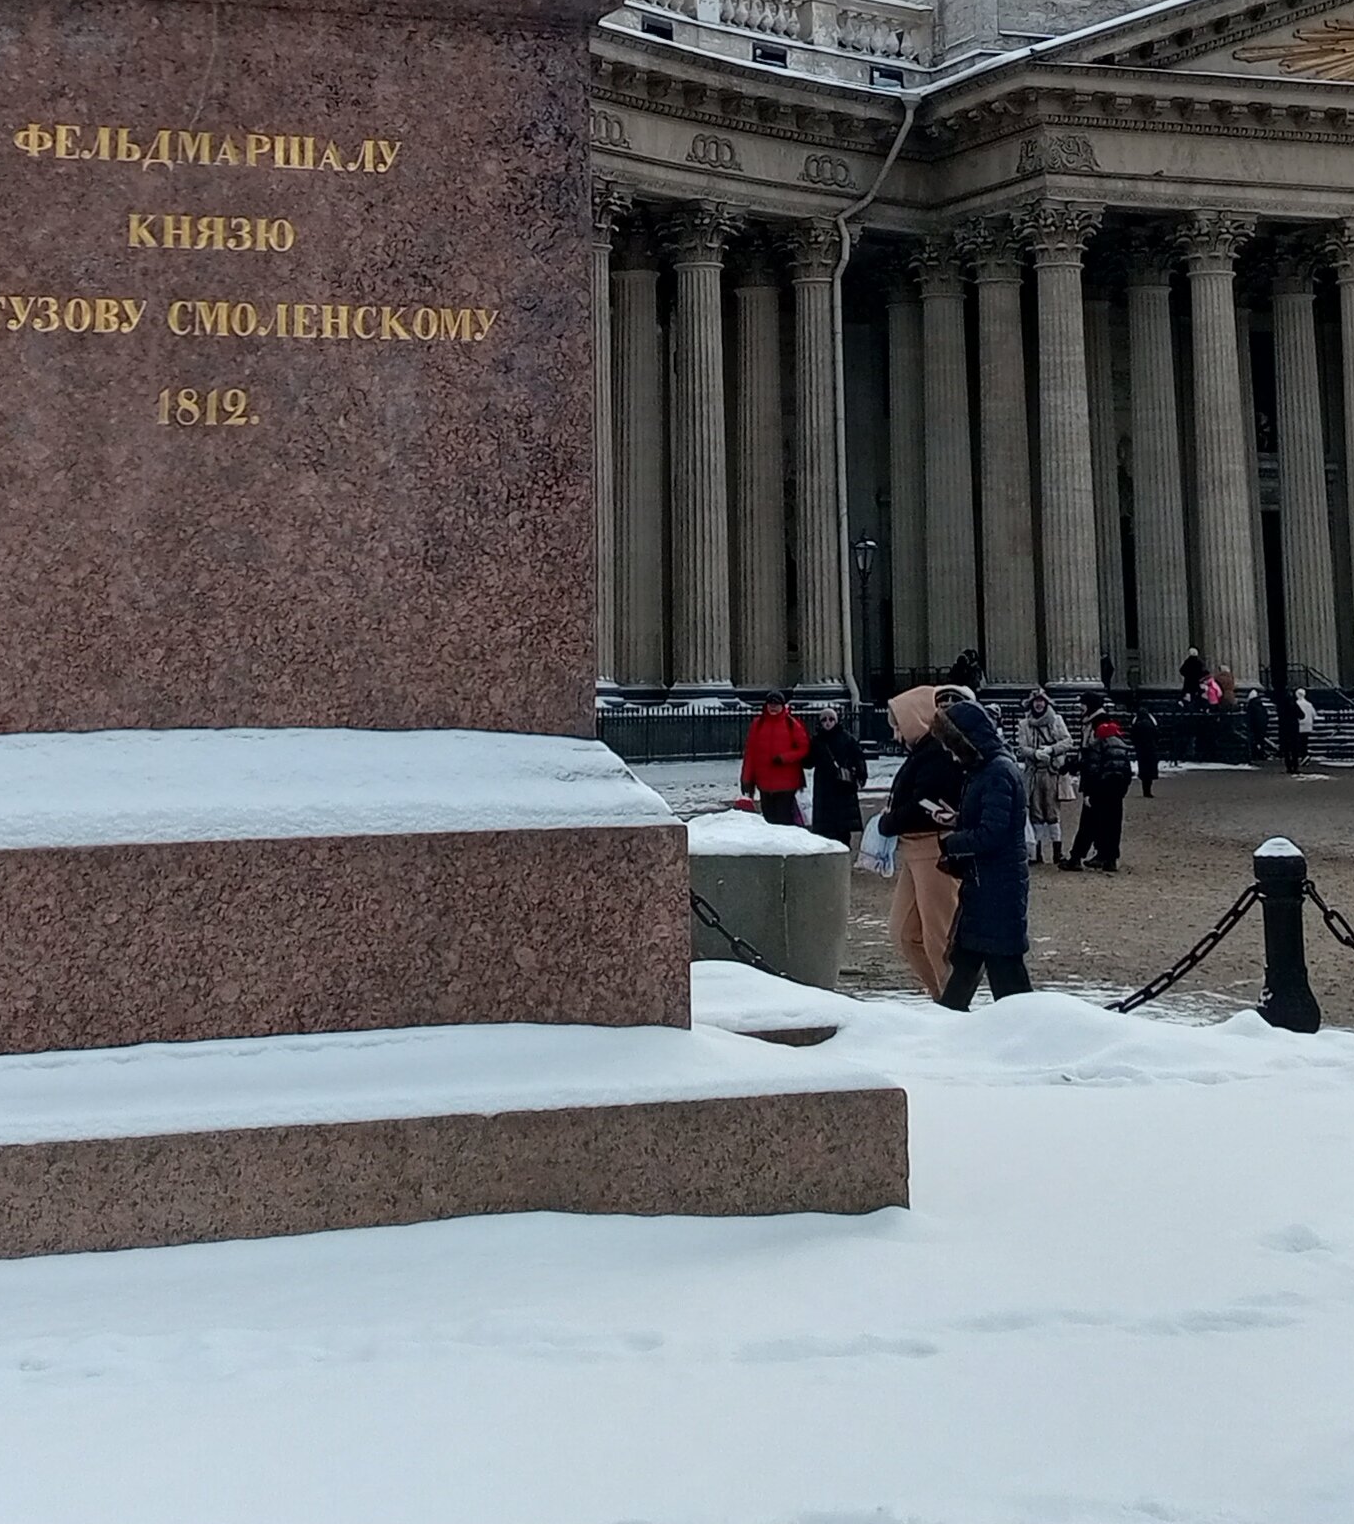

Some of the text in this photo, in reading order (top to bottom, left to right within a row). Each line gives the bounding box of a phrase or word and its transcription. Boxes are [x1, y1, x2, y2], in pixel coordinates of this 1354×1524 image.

[14, 122, 401, 173] ФЕЛЬДМАРШАЛУ
[128, 214, 295, 251] КНЯЗЮ
[167, 299, 500, 342] СМОЛЕНСКОМУ
[157, 387, 261, 426] 1812.
